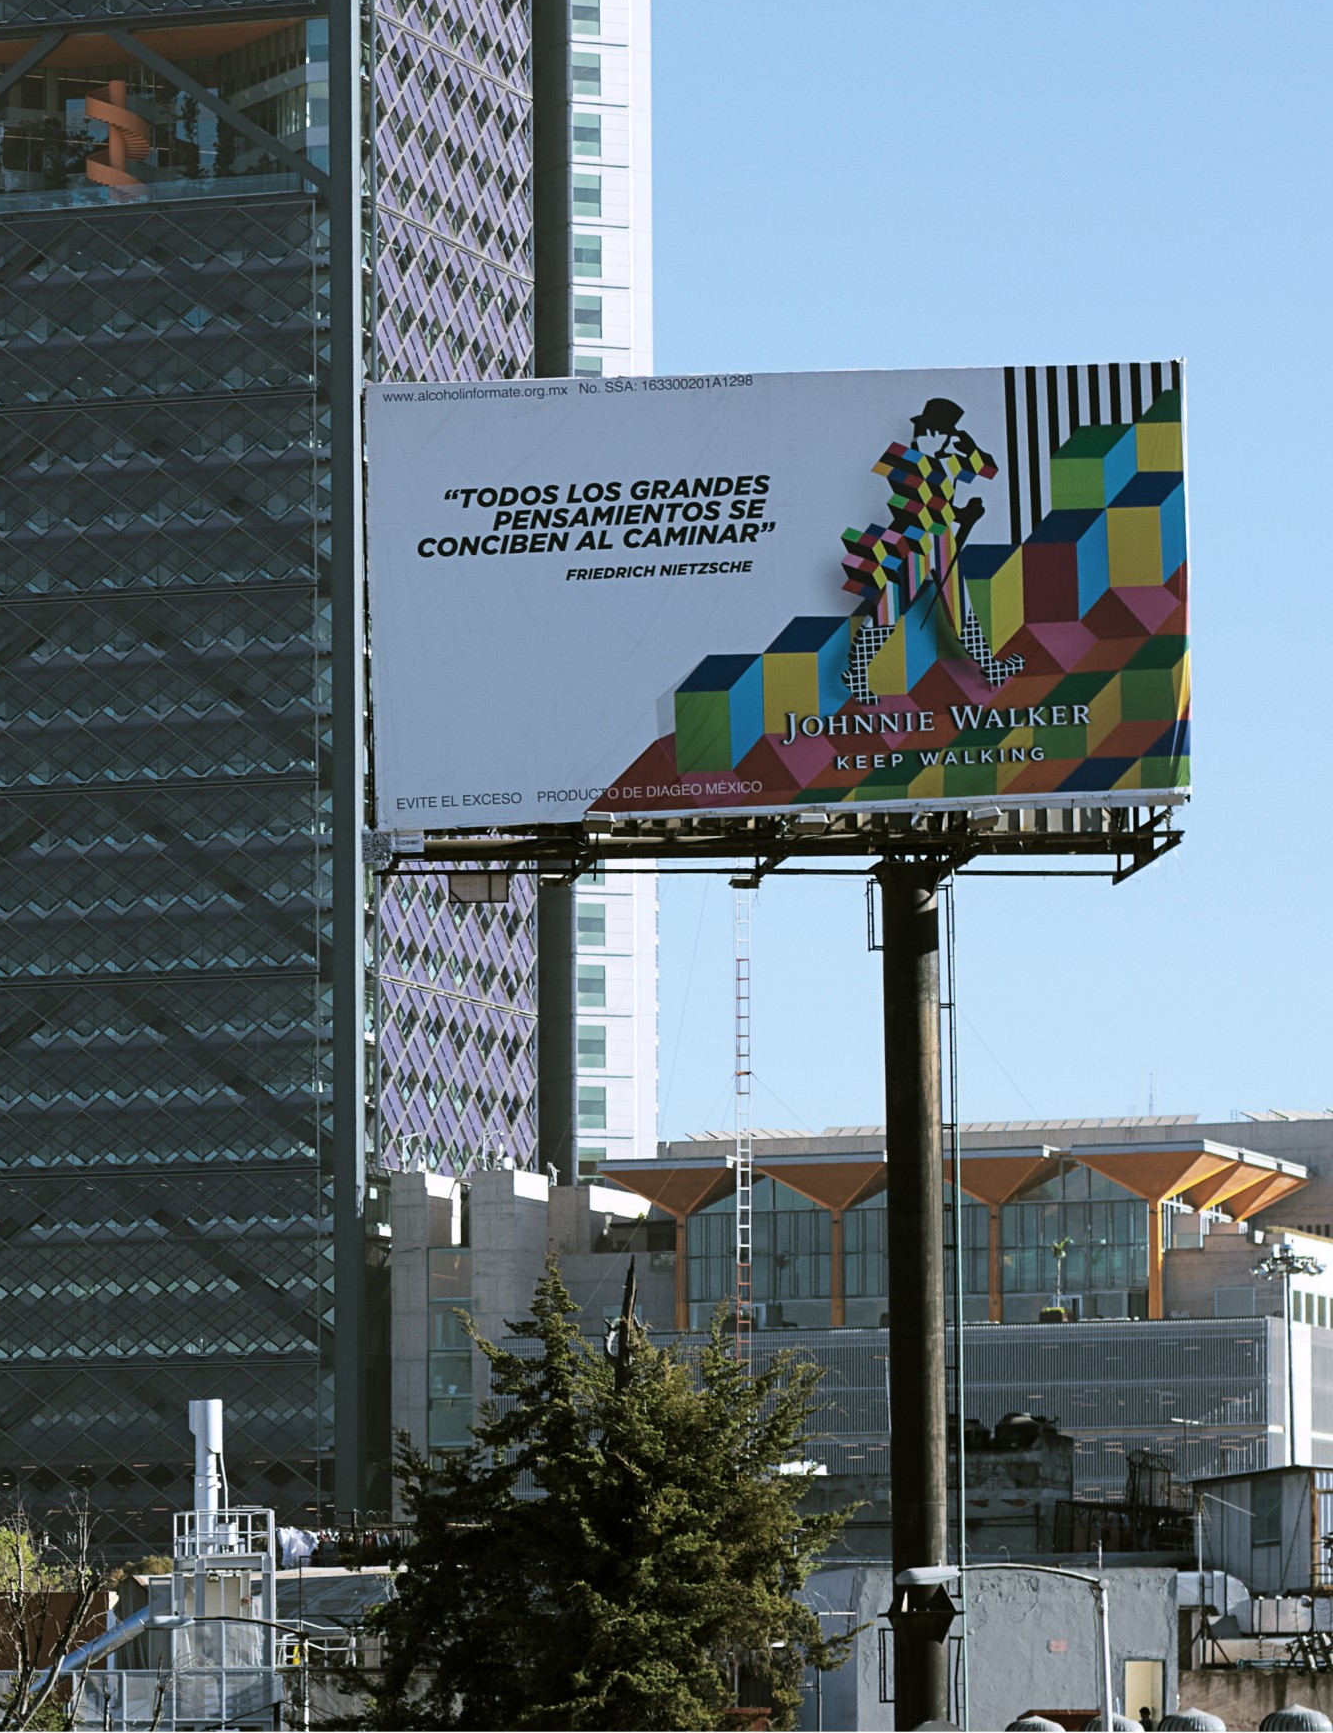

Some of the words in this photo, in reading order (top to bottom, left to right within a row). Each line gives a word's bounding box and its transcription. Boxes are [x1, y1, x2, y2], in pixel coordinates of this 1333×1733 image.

[383, 385, 568, 402] www.alcoholinformate.org.mx
[579, 383, 601, 394] No.
[605, 381, 637, 393] SSA:
[642, 375, 753, 391] 163300201A1298
[566, 482, 622, 504] LOS
[630, 474, 771, 501] GRANDES
[492, 500, 722, 531] PENSAMIENTOS
[728, 499, 766, 520] SE
[417, 532, 570, 558] CONCIBEN
[575, 530, 614, 551] AL
[566, 565, 656, 581] FRIEDRICH
[659, 560, 753, 577] NIETZSCHE
[949, 704, 1091, 731] WALKER
[837, 753, 904, 770] KEEP
[920, 747, 1045, 766] WALKING
[396, 796, 438, 810] EVITE
[442, 795, 459, 807] EL
[462, 792, 522, 806] EXCESO
[537, 785, 620, 803] PRODUCTO
[623, 786, 642, 799] DE
[646, 783, 702, 797] DIAGEO
[706, 779, 763, 795] MÉXICO
